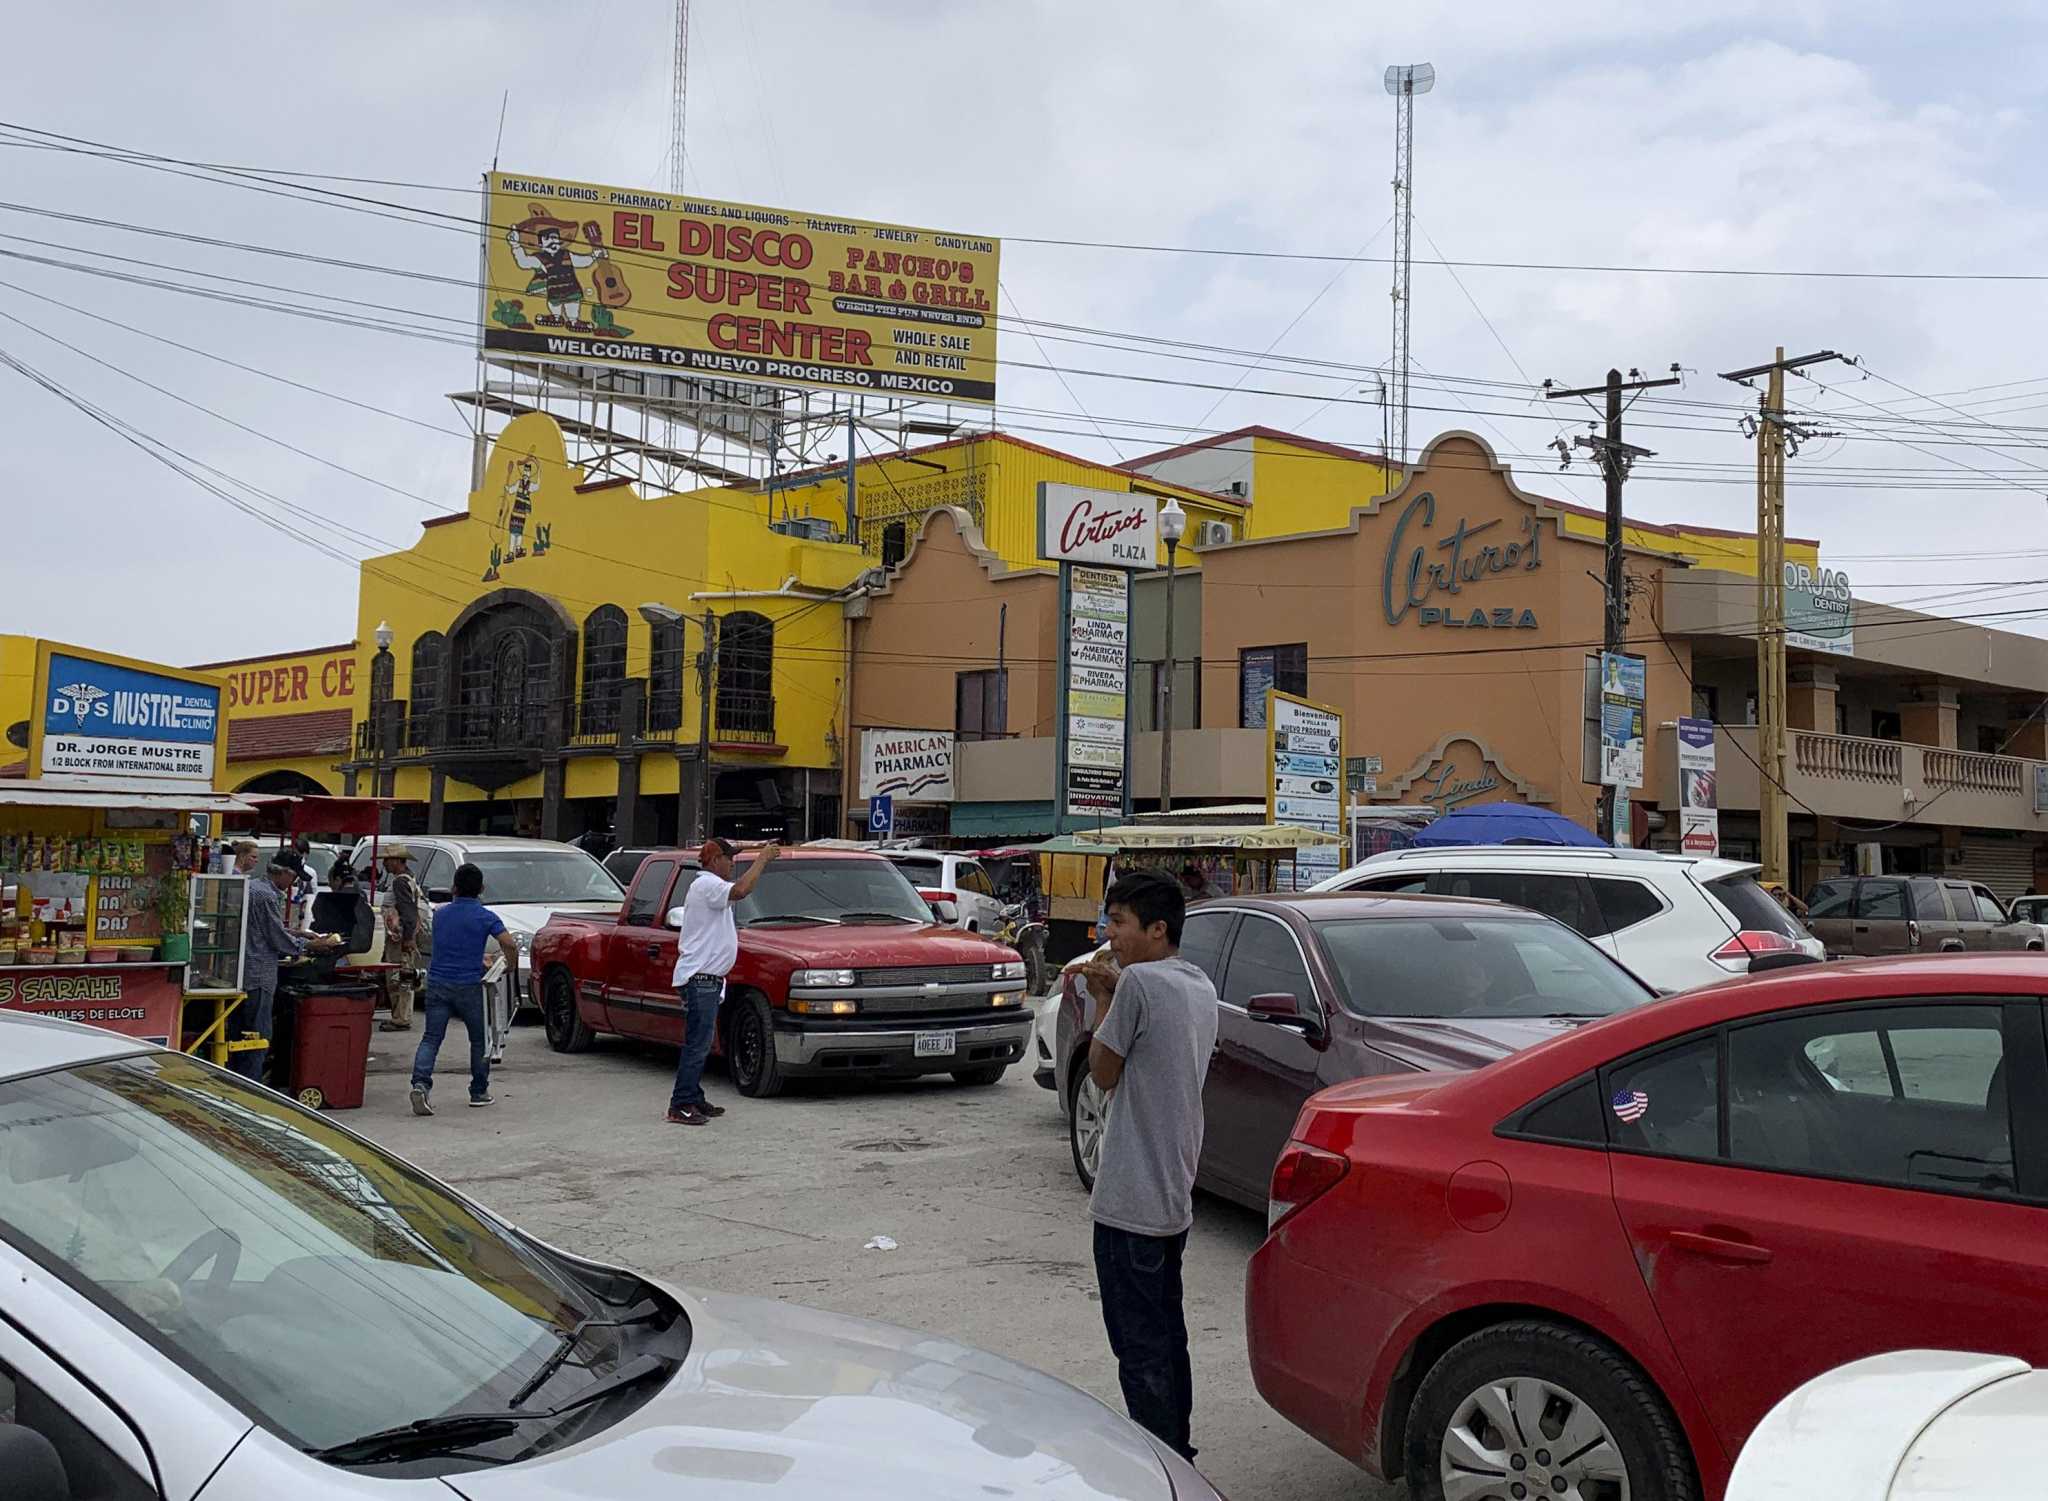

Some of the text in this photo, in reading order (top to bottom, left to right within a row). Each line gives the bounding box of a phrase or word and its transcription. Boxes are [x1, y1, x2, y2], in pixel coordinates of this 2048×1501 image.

[502, 179, 993, 253] MEXICAN CURIOS PHARMACY WINES AND LIQUORS TALAVERA JEWELRY CANDYLAND
[612, 210, 813, 270] EL DISCO
[846, 247, 974, 284] PANCHO'S
[666, 262, 812, 315] SUPER
[828, 270, 883, 298] BAR
[912, 282, 990, 311] GRILL
[836, 301, 982, 326] WHERE THE FUN NEVER ENDS
[706, 313, 873, 366] CENTER
[893, 328, 970, 351] WHOLE SALE
[548, 338, 954, 393] WELCOME TO NUEVO PROGRESO, MEXICO
[895, 350, 966, 371] AND RETAIL
[1060, 500, 1148, 554] Arturo's
[1112, 544, 1146, 560] PLAZA
[1814, 598, 1849, 613] DENTIST
[1088, 620, 1112, 630] LINDA
[1418, 607, 1538, 629] PLAZA
[1077, 627, 1124, 640] PHARMACY
[1080, 652, 1124, 665] PHARMACY
[1083, 645, 1123, 656] AMERICAN
[1080, 676, 1123, 689] PHARMACY
[1088, 670, 1114, 680] RIVERA
[112, 691, 182, 728] MUSTRE
[184, 697, 212, 709] DENTAL
[181, 718, 211, 730] CLINIC
[56, 742, 201, 760] DR. JORGE MUSTRE
[874, 736, 947, 757] AMERICAN
[52, 757, 203, 774] 1/2 BLOCK FROM INTERNATIONAL BRIDGE
[875, 752, 951, 774] PHARMACY
[1420, 762, 1498, 802] Linda
[1070, 792, 1120, 802] INNOVATION
[97, 917, 129, 931] DAS
[20, 976, 122, 1003] SARAHI
[90, 1009, 104, 1019] DE
[108, 1008, 145, 1019] ELOTE
